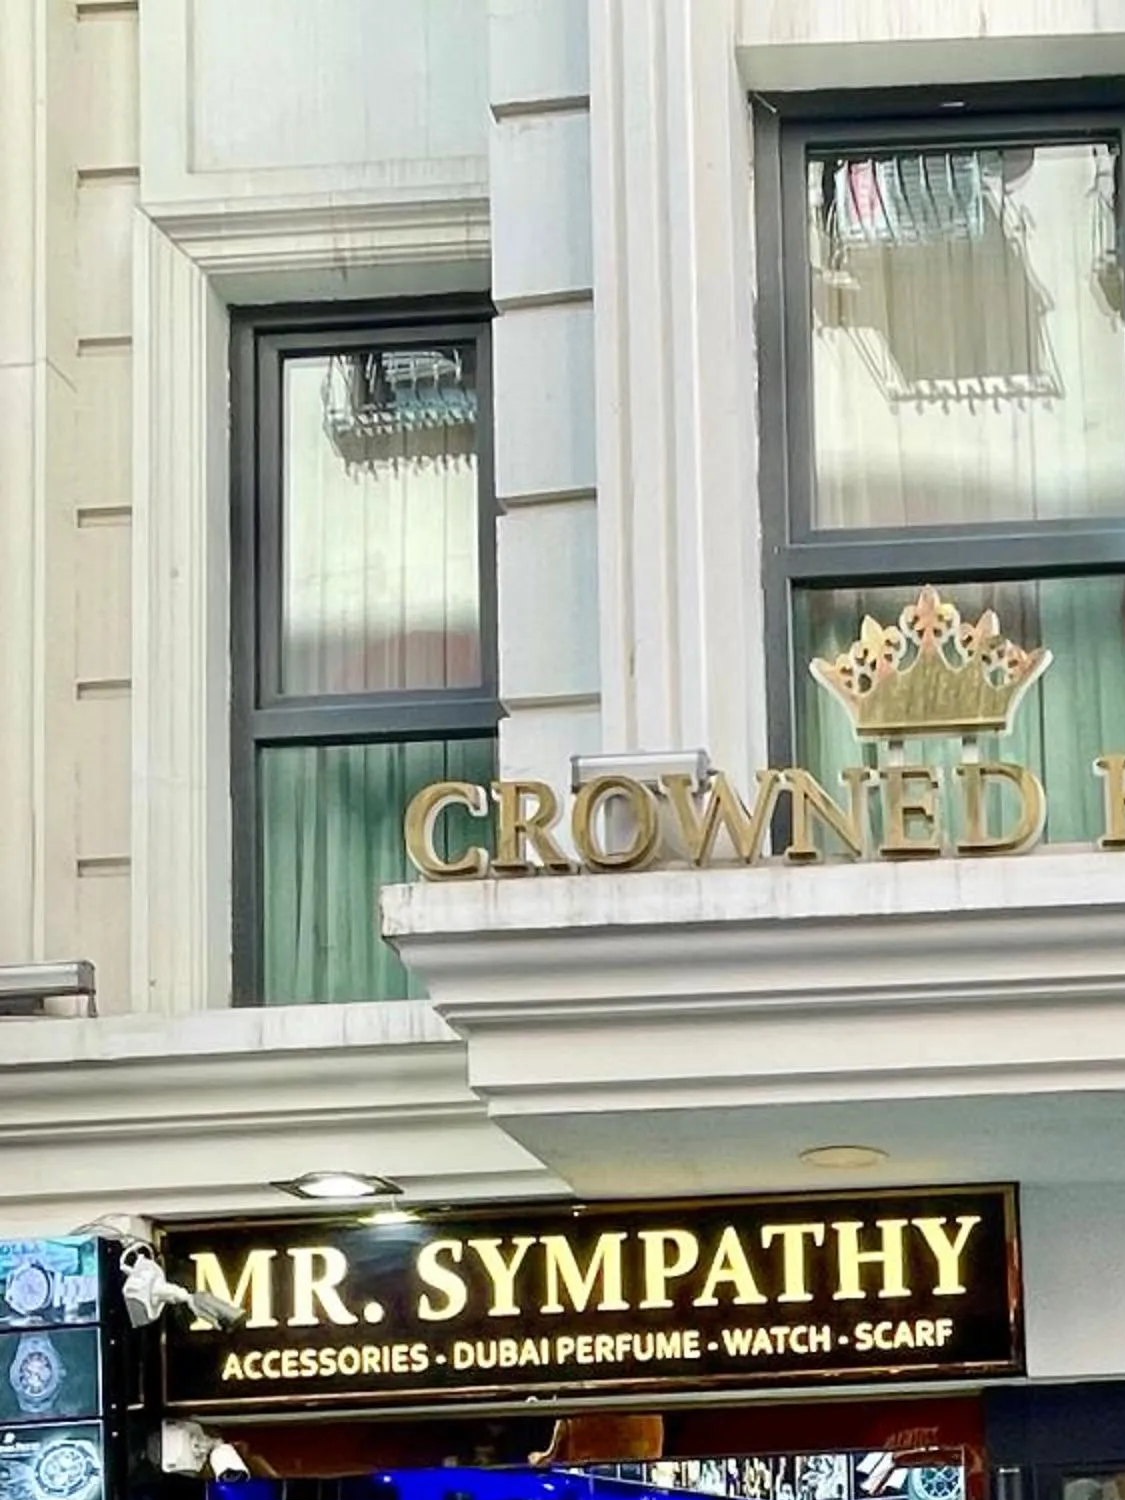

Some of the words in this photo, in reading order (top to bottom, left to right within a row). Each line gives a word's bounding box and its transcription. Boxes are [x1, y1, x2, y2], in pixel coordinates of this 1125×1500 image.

[404, 765, 1047, 880] CROWNED
[189, 1246, 384, 1331] MR.
[417, 1216, 981, 1321] SYMPATHY
[222, 1343, 430, 1380] ACCESSORIES
[454, 1338, 549, 1371] DUBAI
[556, 1330, 700, 1365] PERFUME
[722, 1325, 831, 1356] WATCH
[854, 1319, 954, 1351] SCARF
